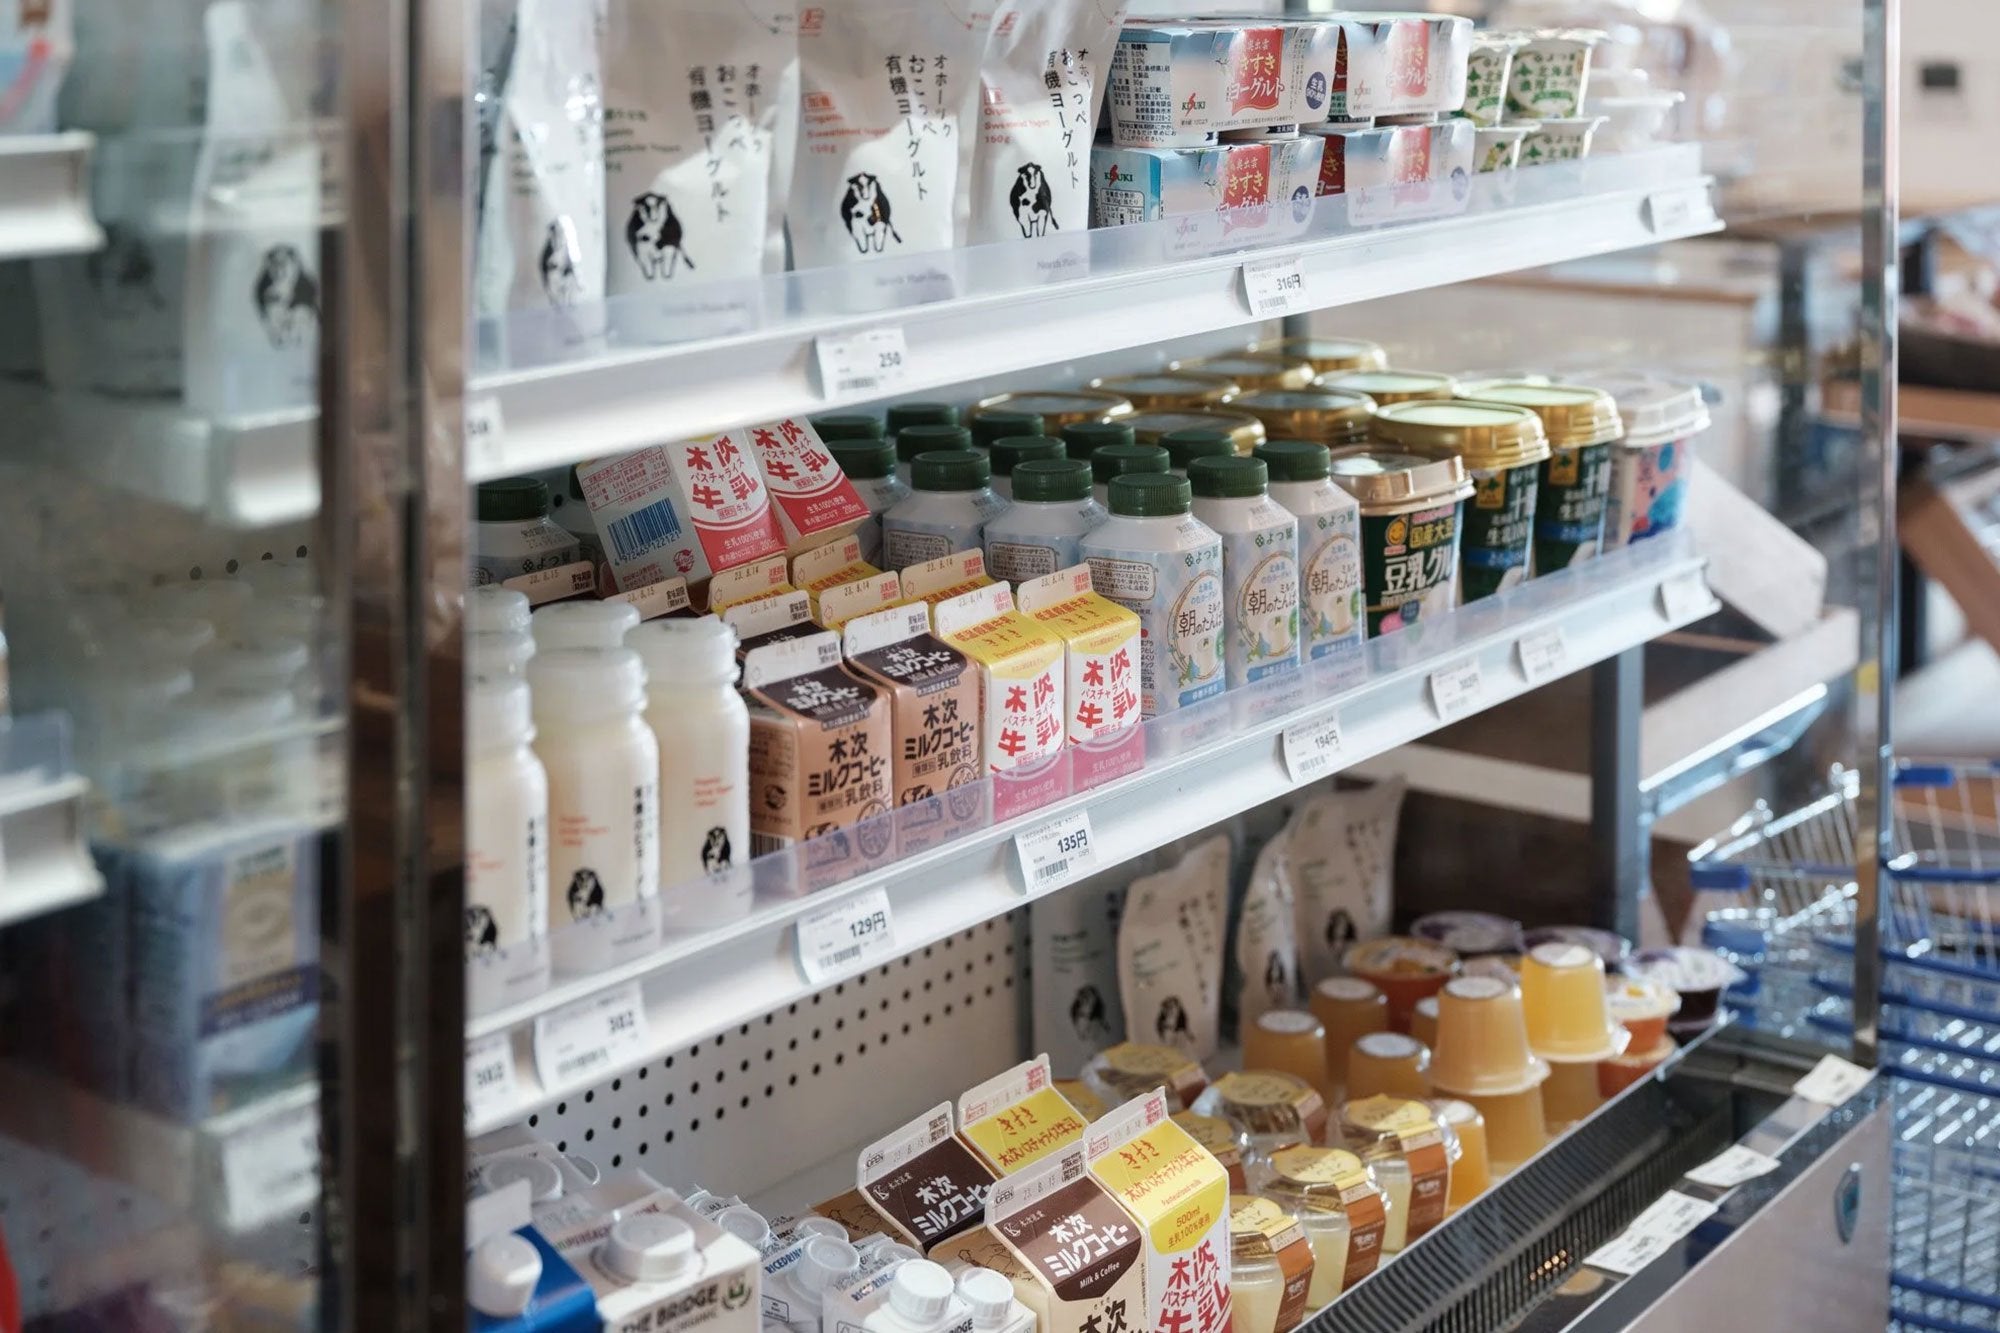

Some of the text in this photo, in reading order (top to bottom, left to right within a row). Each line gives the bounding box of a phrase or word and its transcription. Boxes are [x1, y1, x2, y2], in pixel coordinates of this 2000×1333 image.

[1239, 53, 1276, 77] きすき
[909, 54, 937, 135] おこっぺ
[934, 54, 951, 138] オホーツク
[1229, 77, 1282, 101] ヨーグルト
[885, 55, 928, 201] 有機ヨーグルト
[1044, 50, 1083, 189] 有機ヨーグルト
[1228, 172, 1264, 197] きすき
[1276, 273, 1301, 291] 316円
[752, 419, 804, 450] 木次
[762, 437, 811, 459] パスチャライズ
[686, 435, 739, 471] 木次
[767, 448, 829, 481] 牛乳
[690, 457, 745, 483] パスチャライズ
[692, 471, 759, 510] 牛乳
[807, 495, 847, 515] 生乳100%使用
[1329, 511, 1354, 526] よつ葉
[1410, 516, 1454, 548] 国産大豆
[651, 530, 680, 550] 122121
[724, 530, 766, 548] 生乳100%使用
[1266, 527, 1293, 545] よつ葉
[1195, 547, 1218, 564] よつ葉
[1381, 545, 1452, 595] 豆乳グル
[1280, 582, 1295, 594] ミルク
[1311, 569, 1359, 596] 朝のたんぱ
[1248, 588, 1297, 616] 朝のたんぱ
[1178, 610, 1223, 638] 朝のたんぱ
[883, 651, 951, 676] ミルクコーヒー
[886, 647, 921, 664] 木次
[936, 663, 961, 677] Coffee
[1083, 648, 1131, 687] 木次
[792, 680, 828, 695] 木次
[1005, 672, 1054, 713] 木次
[1081, 670, 1132, 699] パスチャライズ
[923, 699, 958, 729] 木次
[1003, 696, 1056, 727] パスチャライズ
[1077, 688, 1137, 729] 牛乳
[829, 732, 867, 763] 木次
[905, 722, 975, 760] ミルクコーヒー
[998, 714, 1060, 757] 牛乳
[1315, 730, 1339, 749] 194円
[938, 743, 972, 770] 乳飲料
[808, 756, 885, 796] ミルクコーヒー
[845, 781, 883, 805] 乳飲料
[1057, 829, 1088, 853] 135円
[850, 911, 886, 937] 129円
[997, 1107, 1038, 1135] きすき
[999, 1116, 1082, 1167] 木次パスチャライズ牛乳
[1119, 1140, 1160, 1169] きすき
[866, 1152, 884, 1168] OPEN
[915, 1175, 958, 1204] 木次
[1124, 1148, 1205, 1202] 木次パスチャライズ牛乳
[912, 1184, 991, 1236] ミルクコーヒー
[995, 1189, 1014, 1205] OPEN
[1048, 1213, 1093, 1244] 木次
[1168, 1213, 1211, 1248] 生乳100%使用
[1176, 1205, 1201, 1227] 500ml
[765, 1247, 803, 1274] RICEDRIN
[1043, 1224, 1129, 1278] ミルクコーヒー
[1168, 1240, 1215, 1289] 木次
[1079, 1261, 1121, 1289] Milk & Coffee
[1161, 1258, 1220, 1307] パスチャライズ
[657, 1284, 718, 1326] BRIDGE
[1079, 1299, 1127, 1333] 木次
[1154, 1280, 1231, 1333] 牛乳
